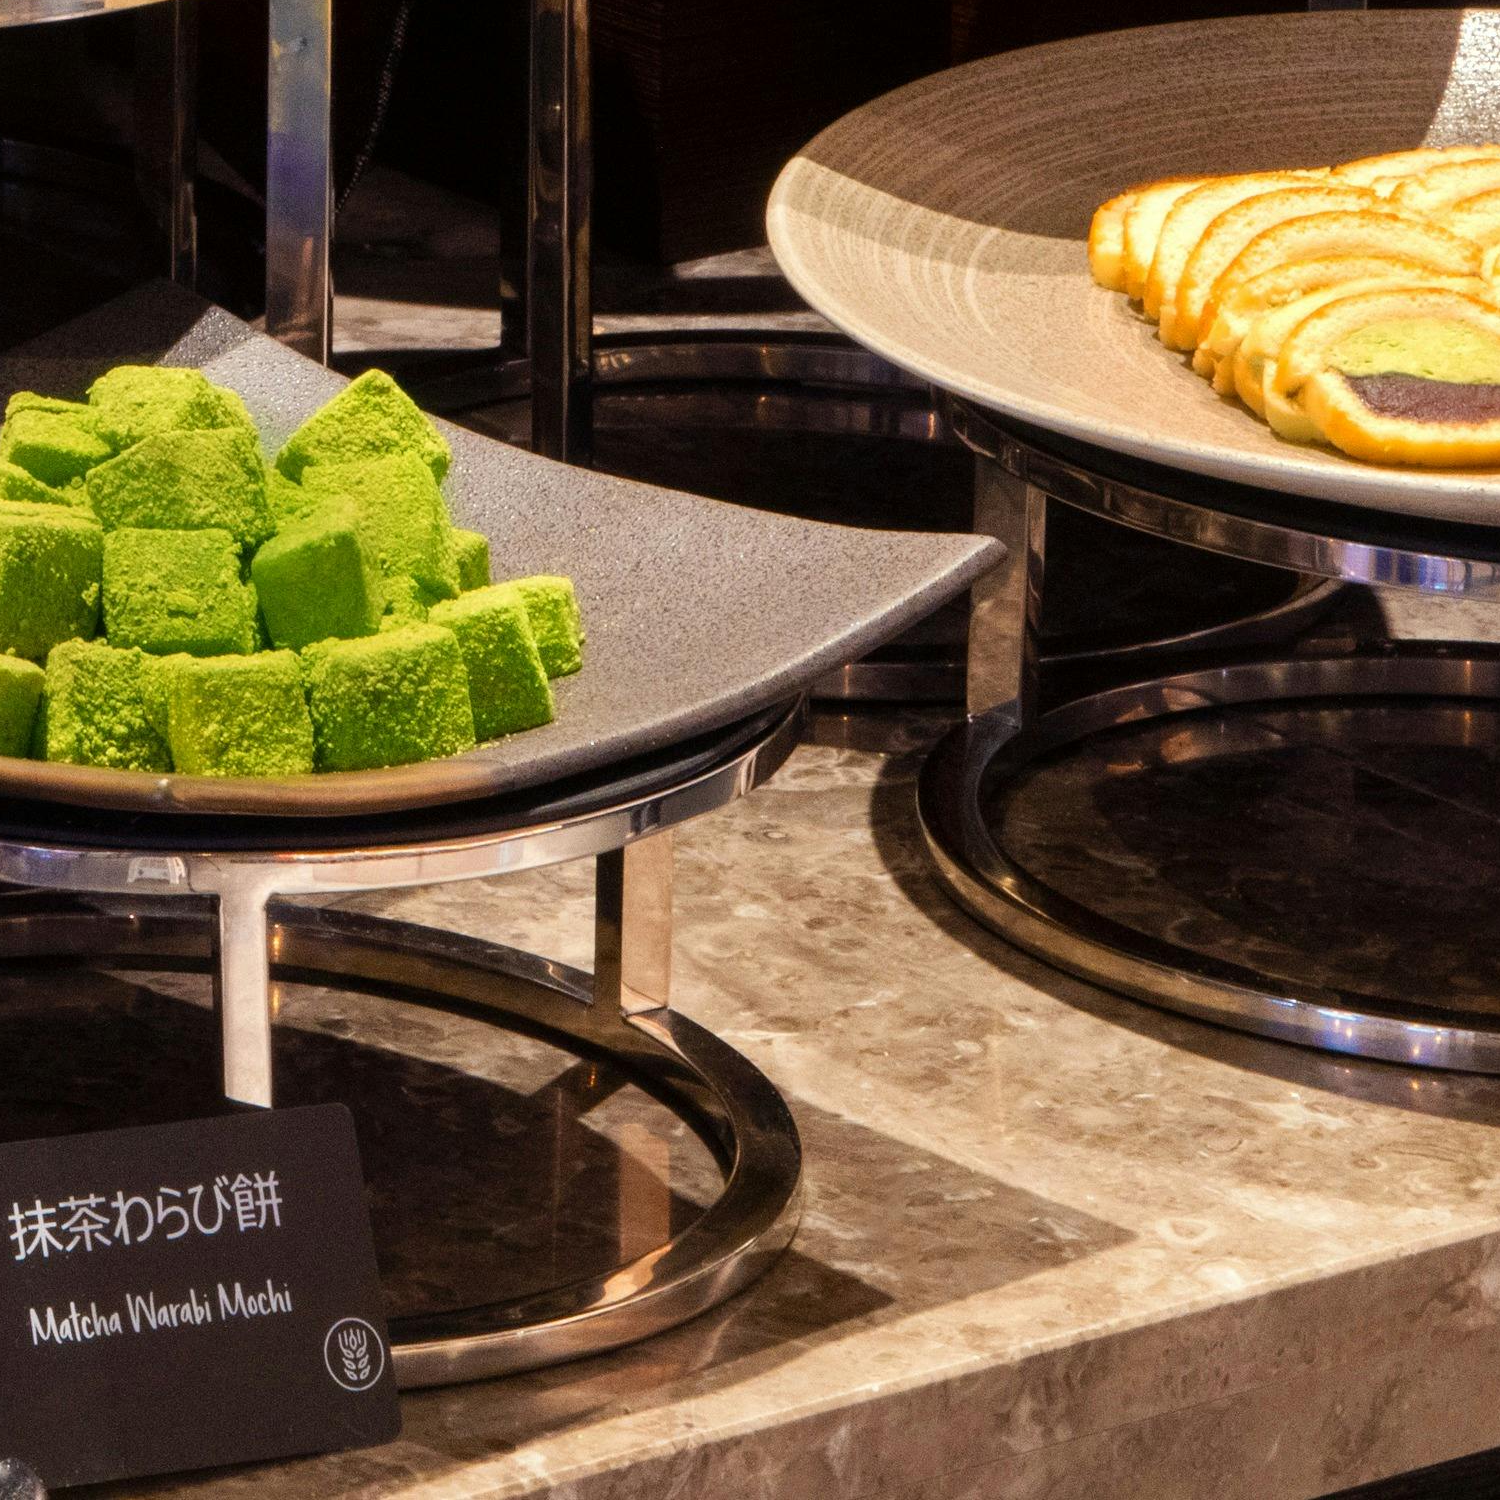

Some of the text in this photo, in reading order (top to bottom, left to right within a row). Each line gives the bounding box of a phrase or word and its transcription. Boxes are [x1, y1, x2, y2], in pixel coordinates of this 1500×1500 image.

[7, 1170, 283, 1261] 抹茶わらび餅
[29, 1279, 292, 1346] Matcha Warabi Mochi
